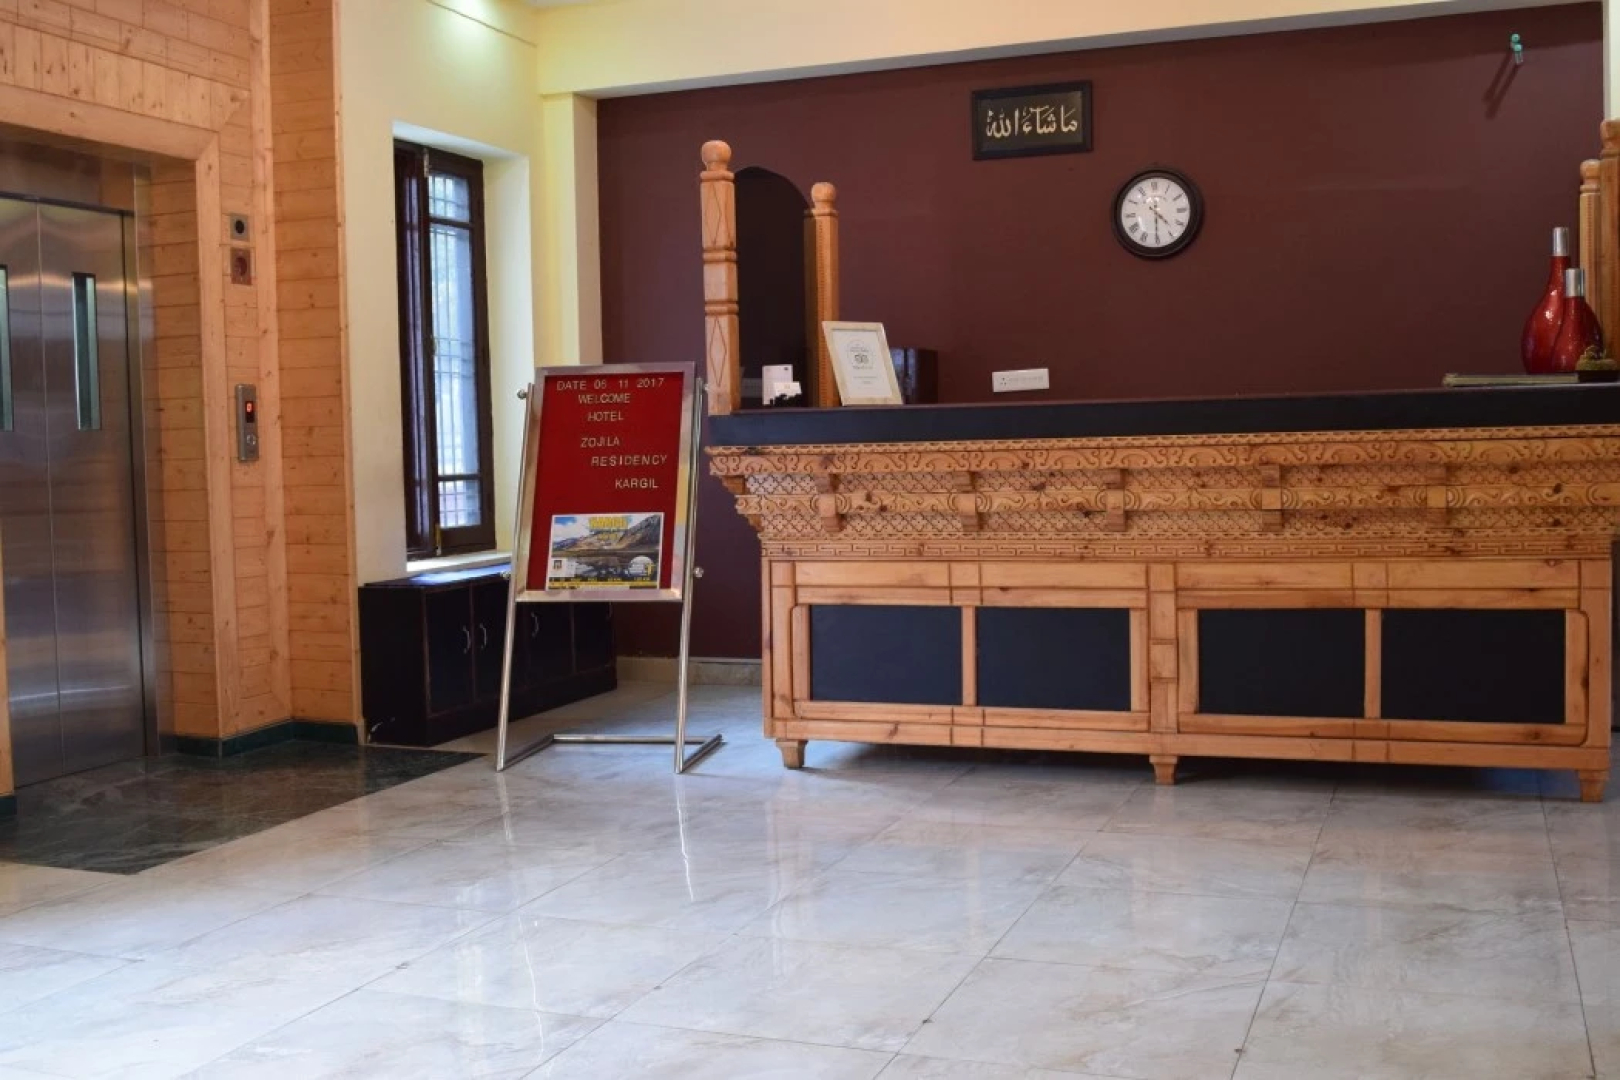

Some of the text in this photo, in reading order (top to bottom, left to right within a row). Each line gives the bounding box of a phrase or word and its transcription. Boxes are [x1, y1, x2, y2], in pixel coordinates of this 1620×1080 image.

[556, 380, 587, 390] DATE
[619, 379, 628, 389] 11
[637, 378, 664, 387] 2017
[579, 393, 631, 404] WELCOME
[588, 411, 624, 421] HOTEL
[580, 437, 620, 448] ZOJILA
[591, 455, 667, 466] RESIDENCY
[615, 478, 659, 489] KARGIL
